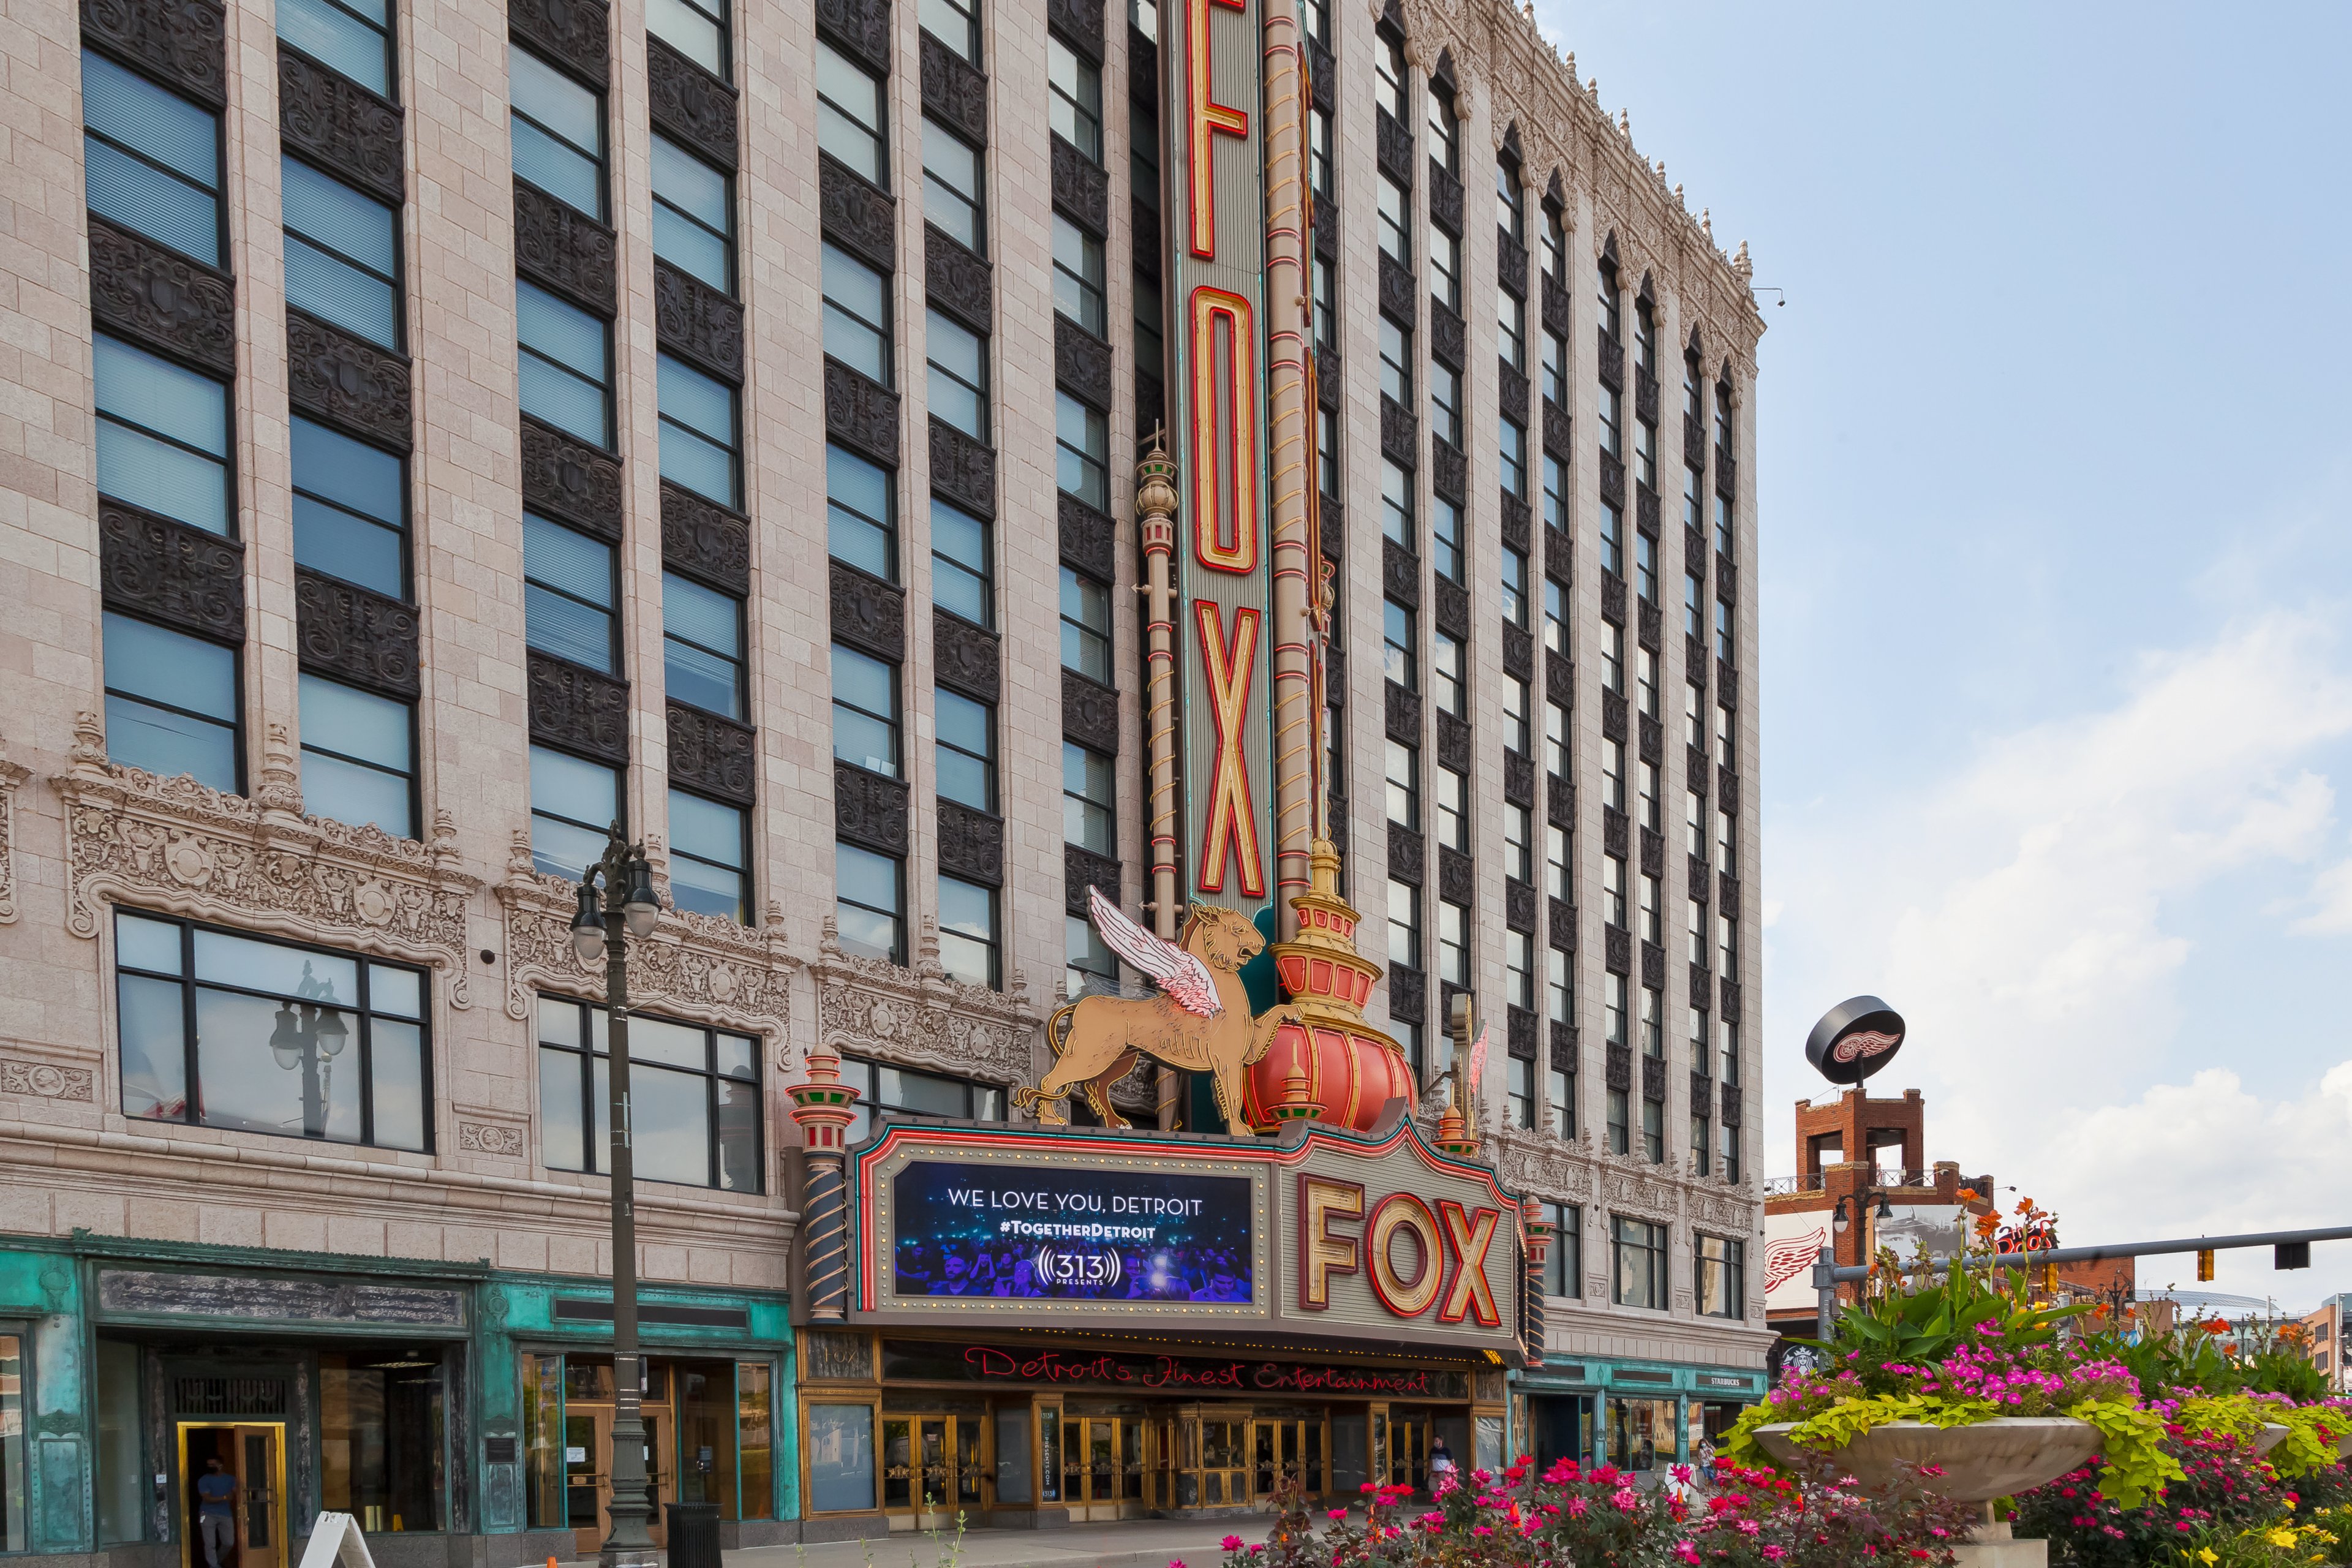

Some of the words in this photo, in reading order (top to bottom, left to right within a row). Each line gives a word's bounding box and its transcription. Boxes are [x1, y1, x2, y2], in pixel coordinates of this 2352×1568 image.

[948, 1188, 984, 1207] WE
[991, 1191, 1049, 1210] LOVE
[1055, 1194, 1106, 1214] YOU,
[1112, 1196, 1203, 1216] DETROIT
[1297, 1172, 1503, 1327] FOX
[1057, 1254, 1104, 1278] 313
[825, 1347, 856, 1363] FOX
[965, 1348, 1131, 1382] Detroit's
[1143, 1355, 1245, 1388] Finest
[1254, 1363, 1430, 1395] Entertainment
[1711, 1378, 1740, 1386] STARBUCKS
